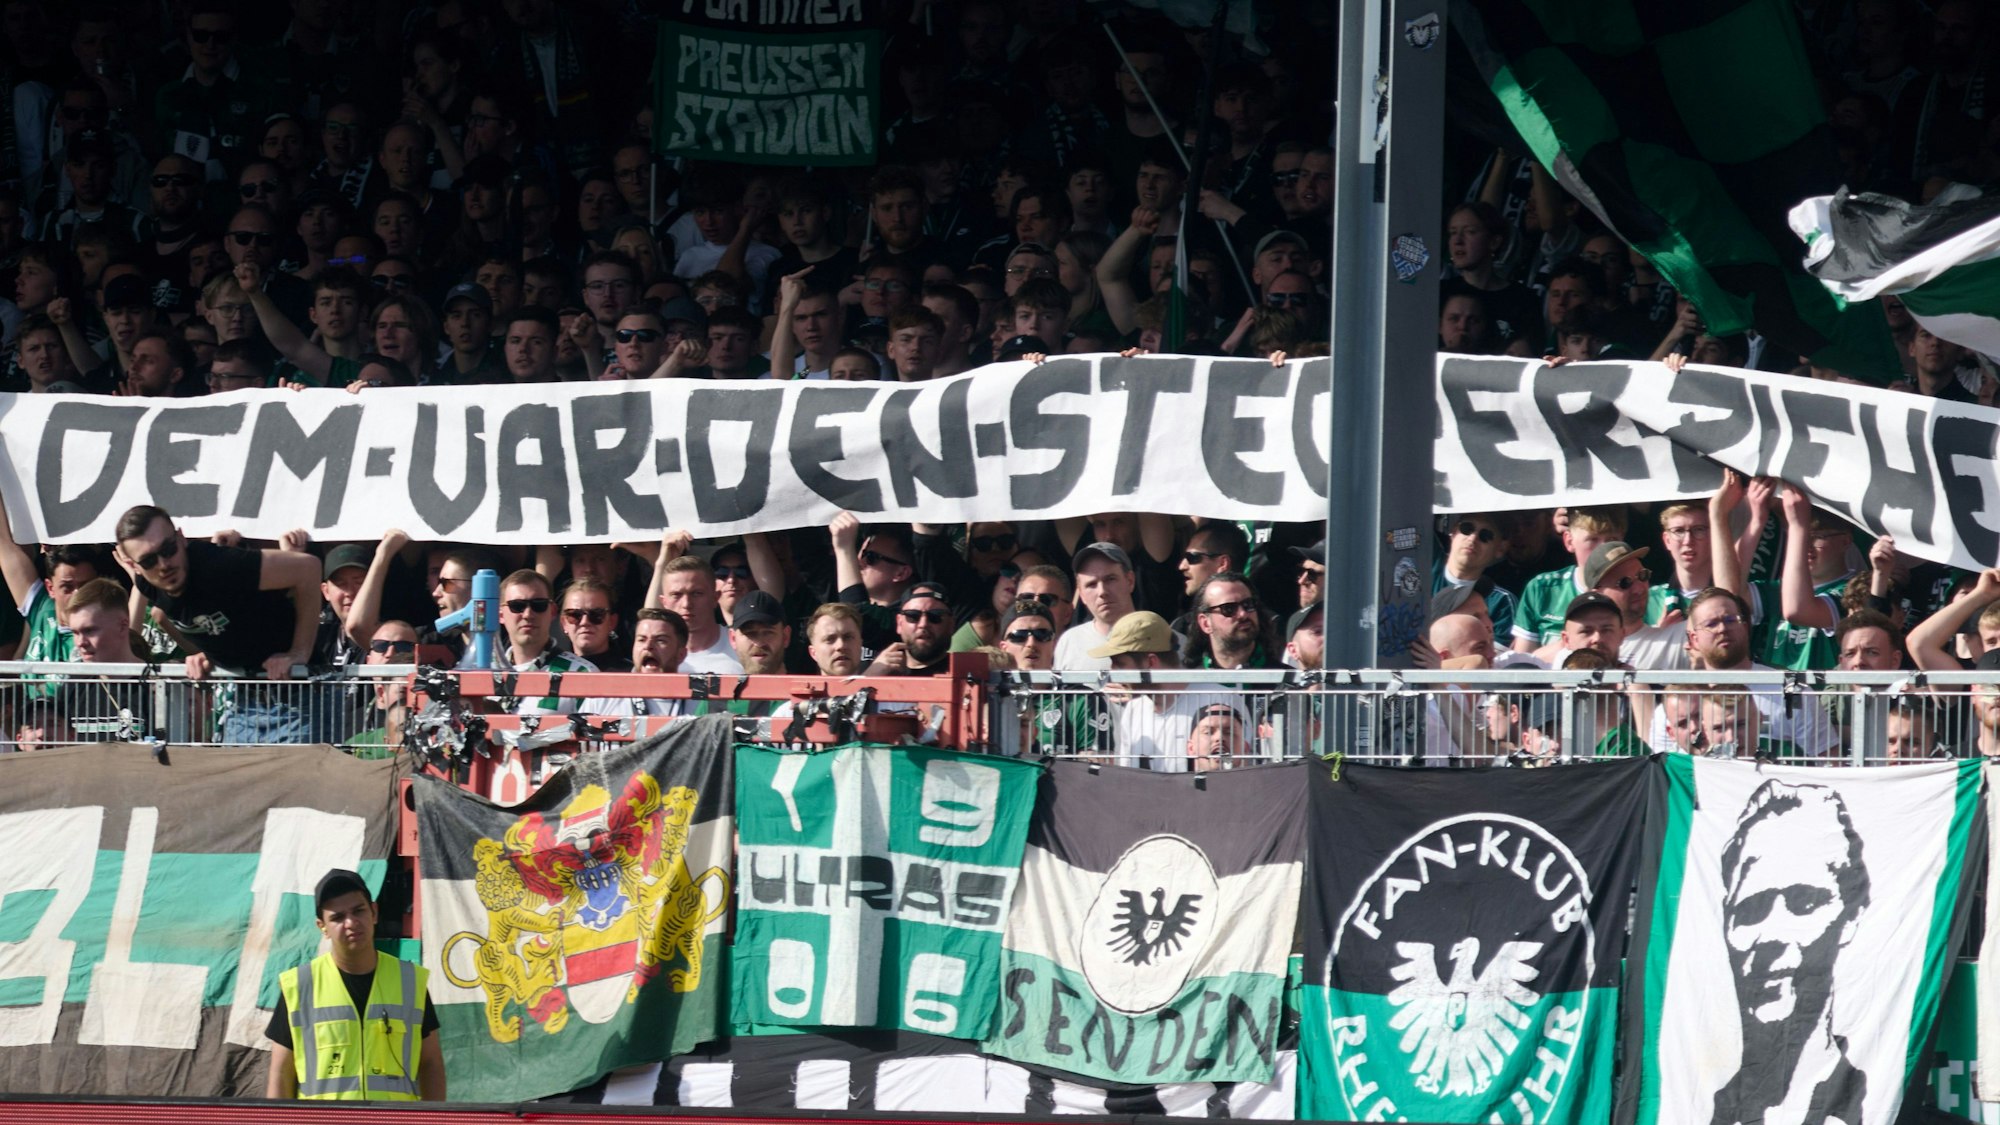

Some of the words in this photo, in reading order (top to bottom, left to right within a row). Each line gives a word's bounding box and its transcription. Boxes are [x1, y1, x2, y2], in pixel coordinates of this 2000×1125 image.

[677, 34, 866, 96] PREUSSEN
[667, 91, 873, 156] STADION
[750, 851, 1003, 926] ULTRAS
[1353, 826, 1584, 940] FAN-KLUB
[1004, 968, 1278, 1076] SENDEN
[327, 1064, 345, 1076] 271
